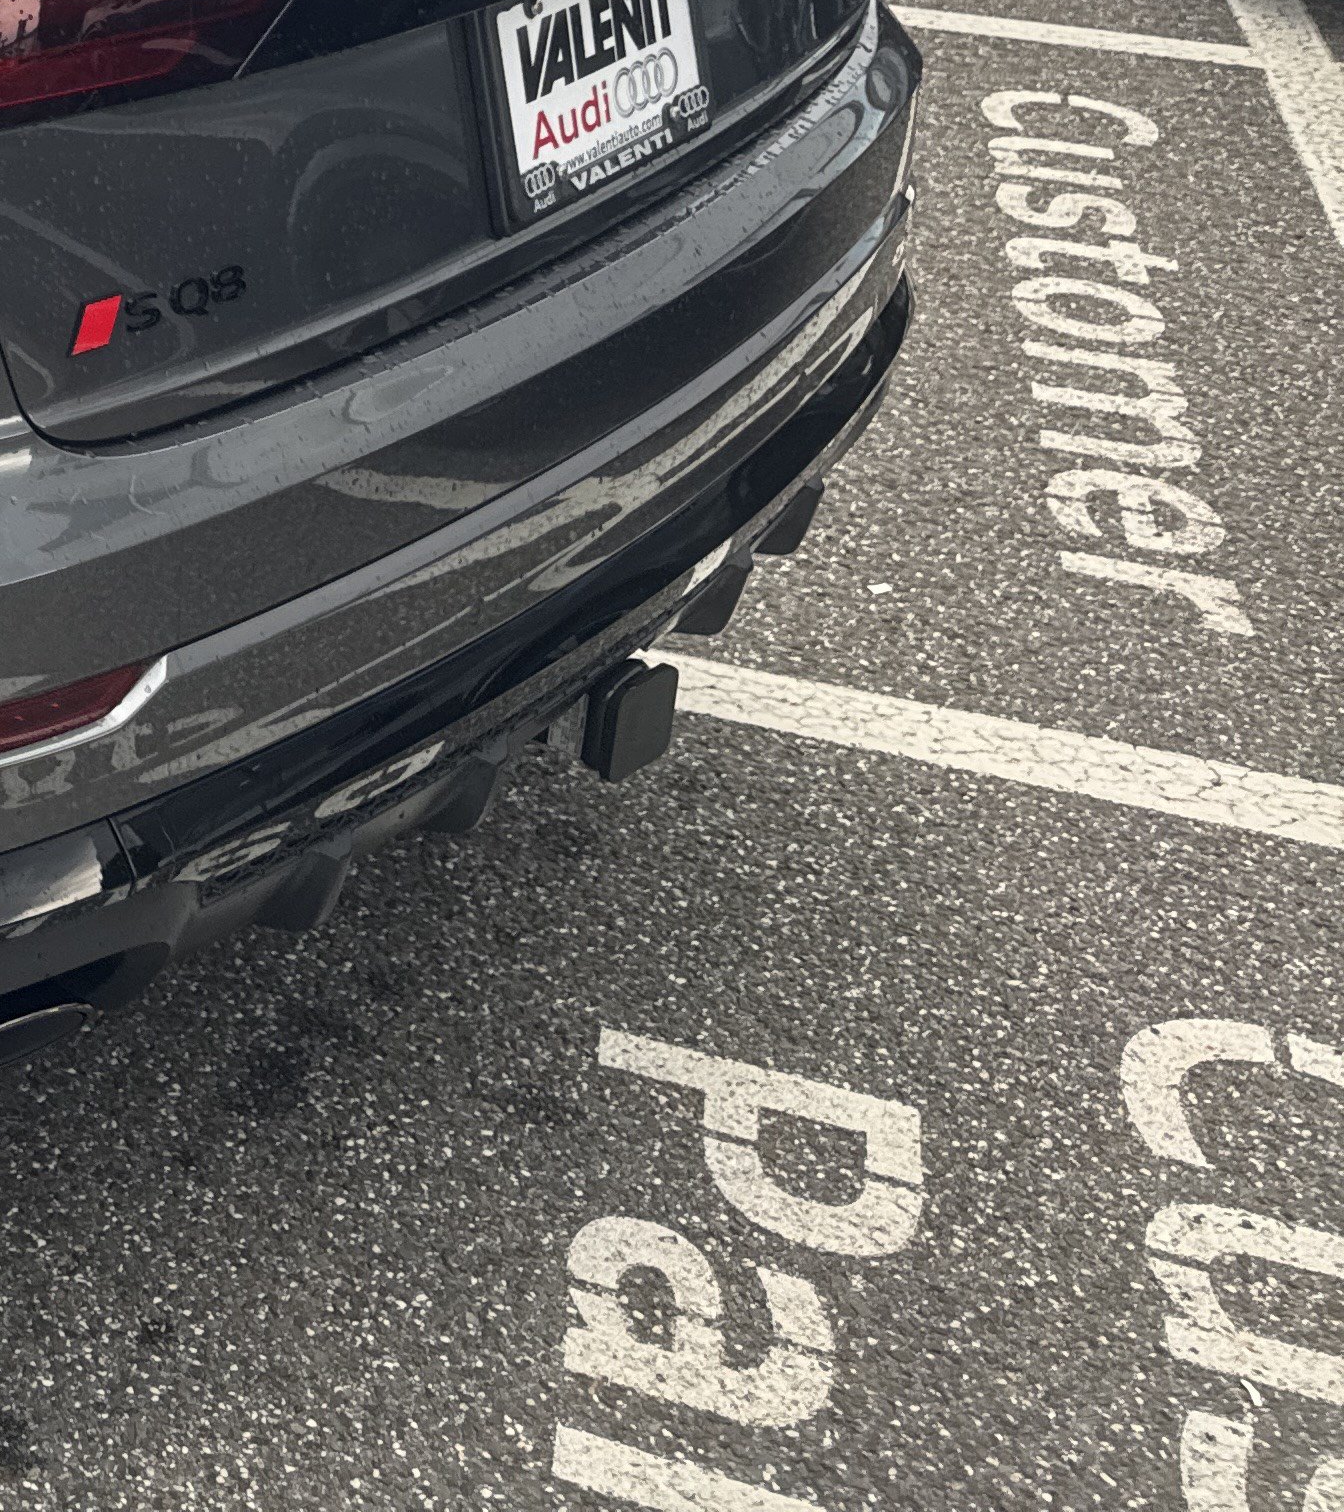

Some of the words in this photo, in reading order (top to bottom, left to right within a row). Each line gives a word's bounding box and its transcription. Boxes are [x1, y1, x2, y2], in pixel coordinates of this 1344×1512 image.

[532, 80, 612, 161] Audi
[565, 113, 663, 172] www.valentiauto.com
[687, 110, 709, 132] Audi
[570, 127, 674, 192] VALENTI
[533, 190, 557, 214] Audi
[980, 90, 1256, 639] Customer
